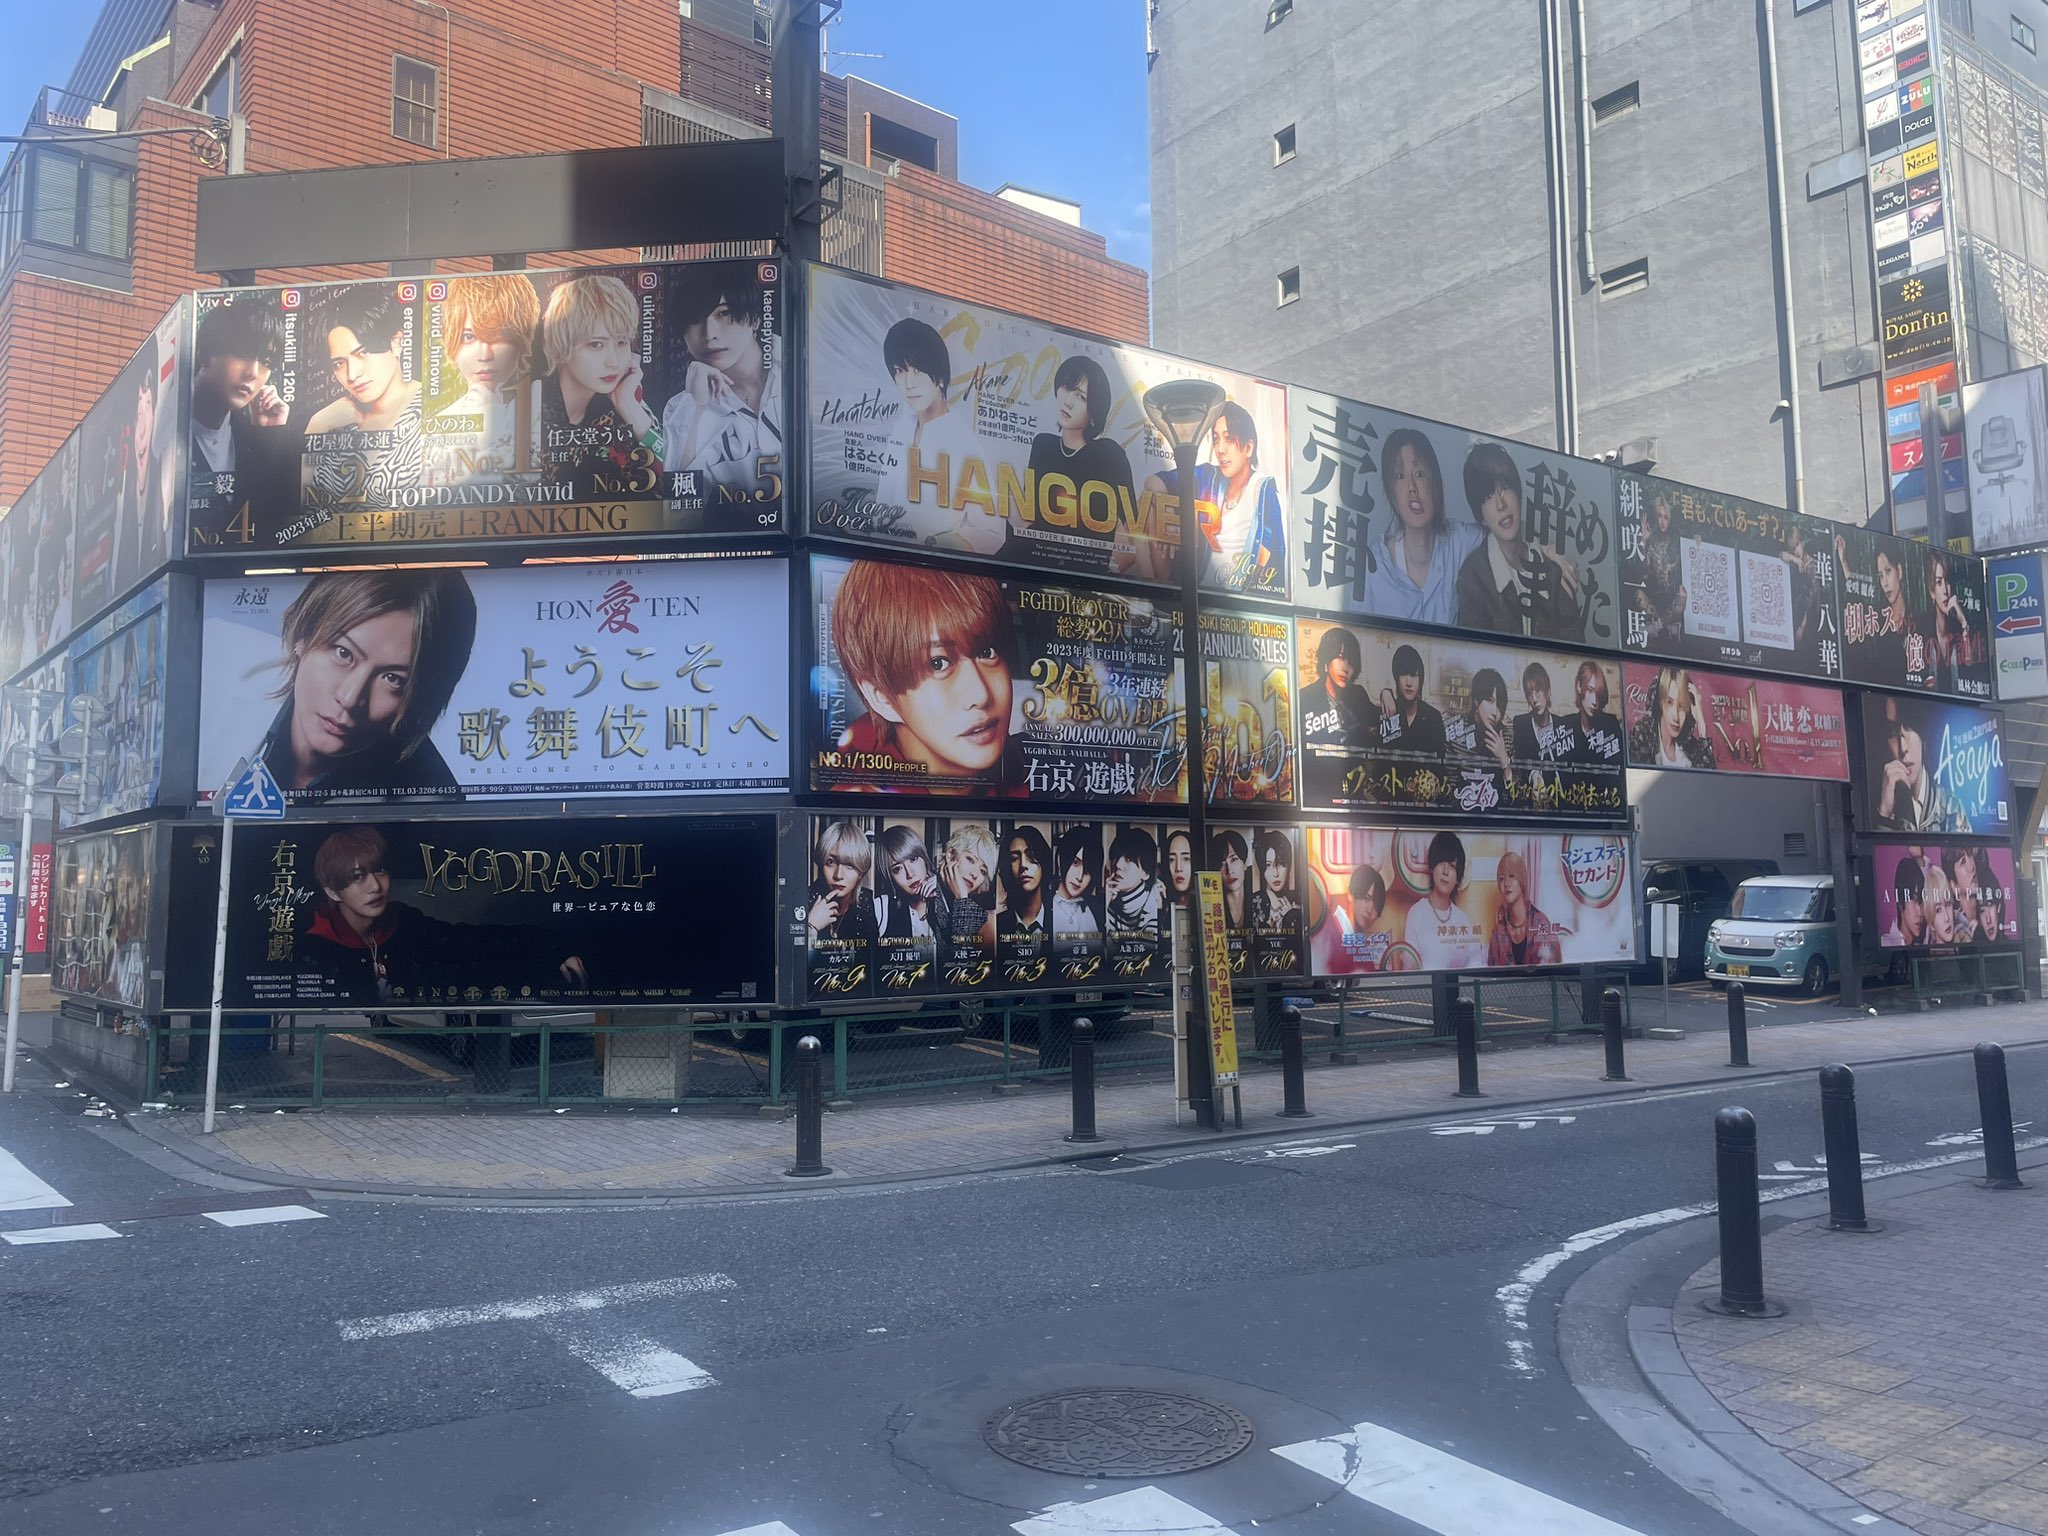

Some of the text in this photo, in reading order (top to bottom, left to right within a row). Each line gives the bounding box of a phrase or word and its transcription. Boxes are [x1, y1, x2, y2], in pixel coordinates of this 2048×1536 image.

[1907, 152, 1938, 172] North
[1879, 252, 1909, 267] ELEGANCE
[642, 295, 655, 364] uikintama
[761, 289, 775, 370] kaedepyoon
[1885, 311, 1950, 341] Donfin
[400, 307, 414, 383] erenguram
[429, 304, 442, 397] vivid_hinowa
[820, 387, 900, 425] Harutokun
[977, 404, 1038, 428] あかねきっど
[425, 417, 476, 434] ひのわ
[546, 426, 634, 448] 任天堂うい
[843, 430, 888, 445] HANG OVER
[304, 433, 354, 452] 花屋敷
[550, 450, 570, 464] 主任
[843, 447, 898, 468] はるとくん
[592, 448, 658, 494] No.3
[671, 471, 697, 497] 楓
[717, 453, 782, 505] No.5
[386, 482, 575, 509] TOPDANDY vivid
[670, 498, 703, 511] 副主任
[1301, 404, 1379, 602] 売掛
[192, 500, 256, 547] No.4
[275, 508, 332, 545] 2023年度
[326, 503, 629, 544] 上半期売上RANKING
[1017, 528, 1037, 538] HANG
[1040, 532, 1058, 541] OVER
[1067, 537, 1088, 546] HANG
[1090, 540, 1107, 549] OVER
[1619, 478, 1649, 649] 緋咲一馬
[232, 586, 270, 607] 永遠
[1995, 572, 2039, 613] P 24h
[535, 579, 701, 634] HON 愛 TEN
[1056, 615, 1129, 645] 総勢29人
[1172, 611, 1286, 639] FUSUKI GROUP HOLDINGS
[1046, 642, 1167, 667] 2023年度 FGHD年間売上
[1203, 635, 1287, 665] ANNUAL SALES
[509, 641, 723, 699] ようこそ
[1107, 673, 1168, 700] 3年連続
[1625, 683, 1648, 705] Ren
[1305, 709, 1338, 736] Sena
[1762, 703, 1794, 733] 天使
[457, 703, 781, 762] 歌舞伎町へ
[1024, 722, 1159, 748] ANNUAL SALES 300,000,000 OVER
[470, 760, 770, 775] WELCOME TO KABUKICHO
[818, 750, 927, 773] NO.1/1300 PEOPLE
[1933, 723, 2004, 806] Asaya
[1023, 757, 1076, 793] 右京
[1084, 757, 1136, 796] 遊戯
[418, 842, 657, 898] YGGDRASILL
[1561, 845, 1626, 869] マジェスティ
[30, 854, 41, 907] ご利用できます
[39, 854, 50, 913] クレジットカード
[1573, 864, 1618, 887] セカンド
[266, 839, 298, 962] 右京遊戯
[552, 901, 657, 913] 世界一ピュアな色恋
[1883, 886, 2012, 903] AIR GROUP 最強の店
[38, 915, 45, 923] &
[889, 952, 903, 962] 天月
[953, 949, 983, 959] 天使 ニア
[1017, 947, 1033, 957] SHO
[1270, 940, 1282, 949] YOU
[828, 955, 850, 964] カルマ
[944, 959, 993, 985] No.5
[1004, 956, 1048, 982] No.3
[1061, 955, 1102, 980] No.2
[1212, 902, 1233, 1033] 路線バスの通行に
[814, 963, 866, 993] No.9
[1203, 911, 1226, 1065] ご協力お願いします。
